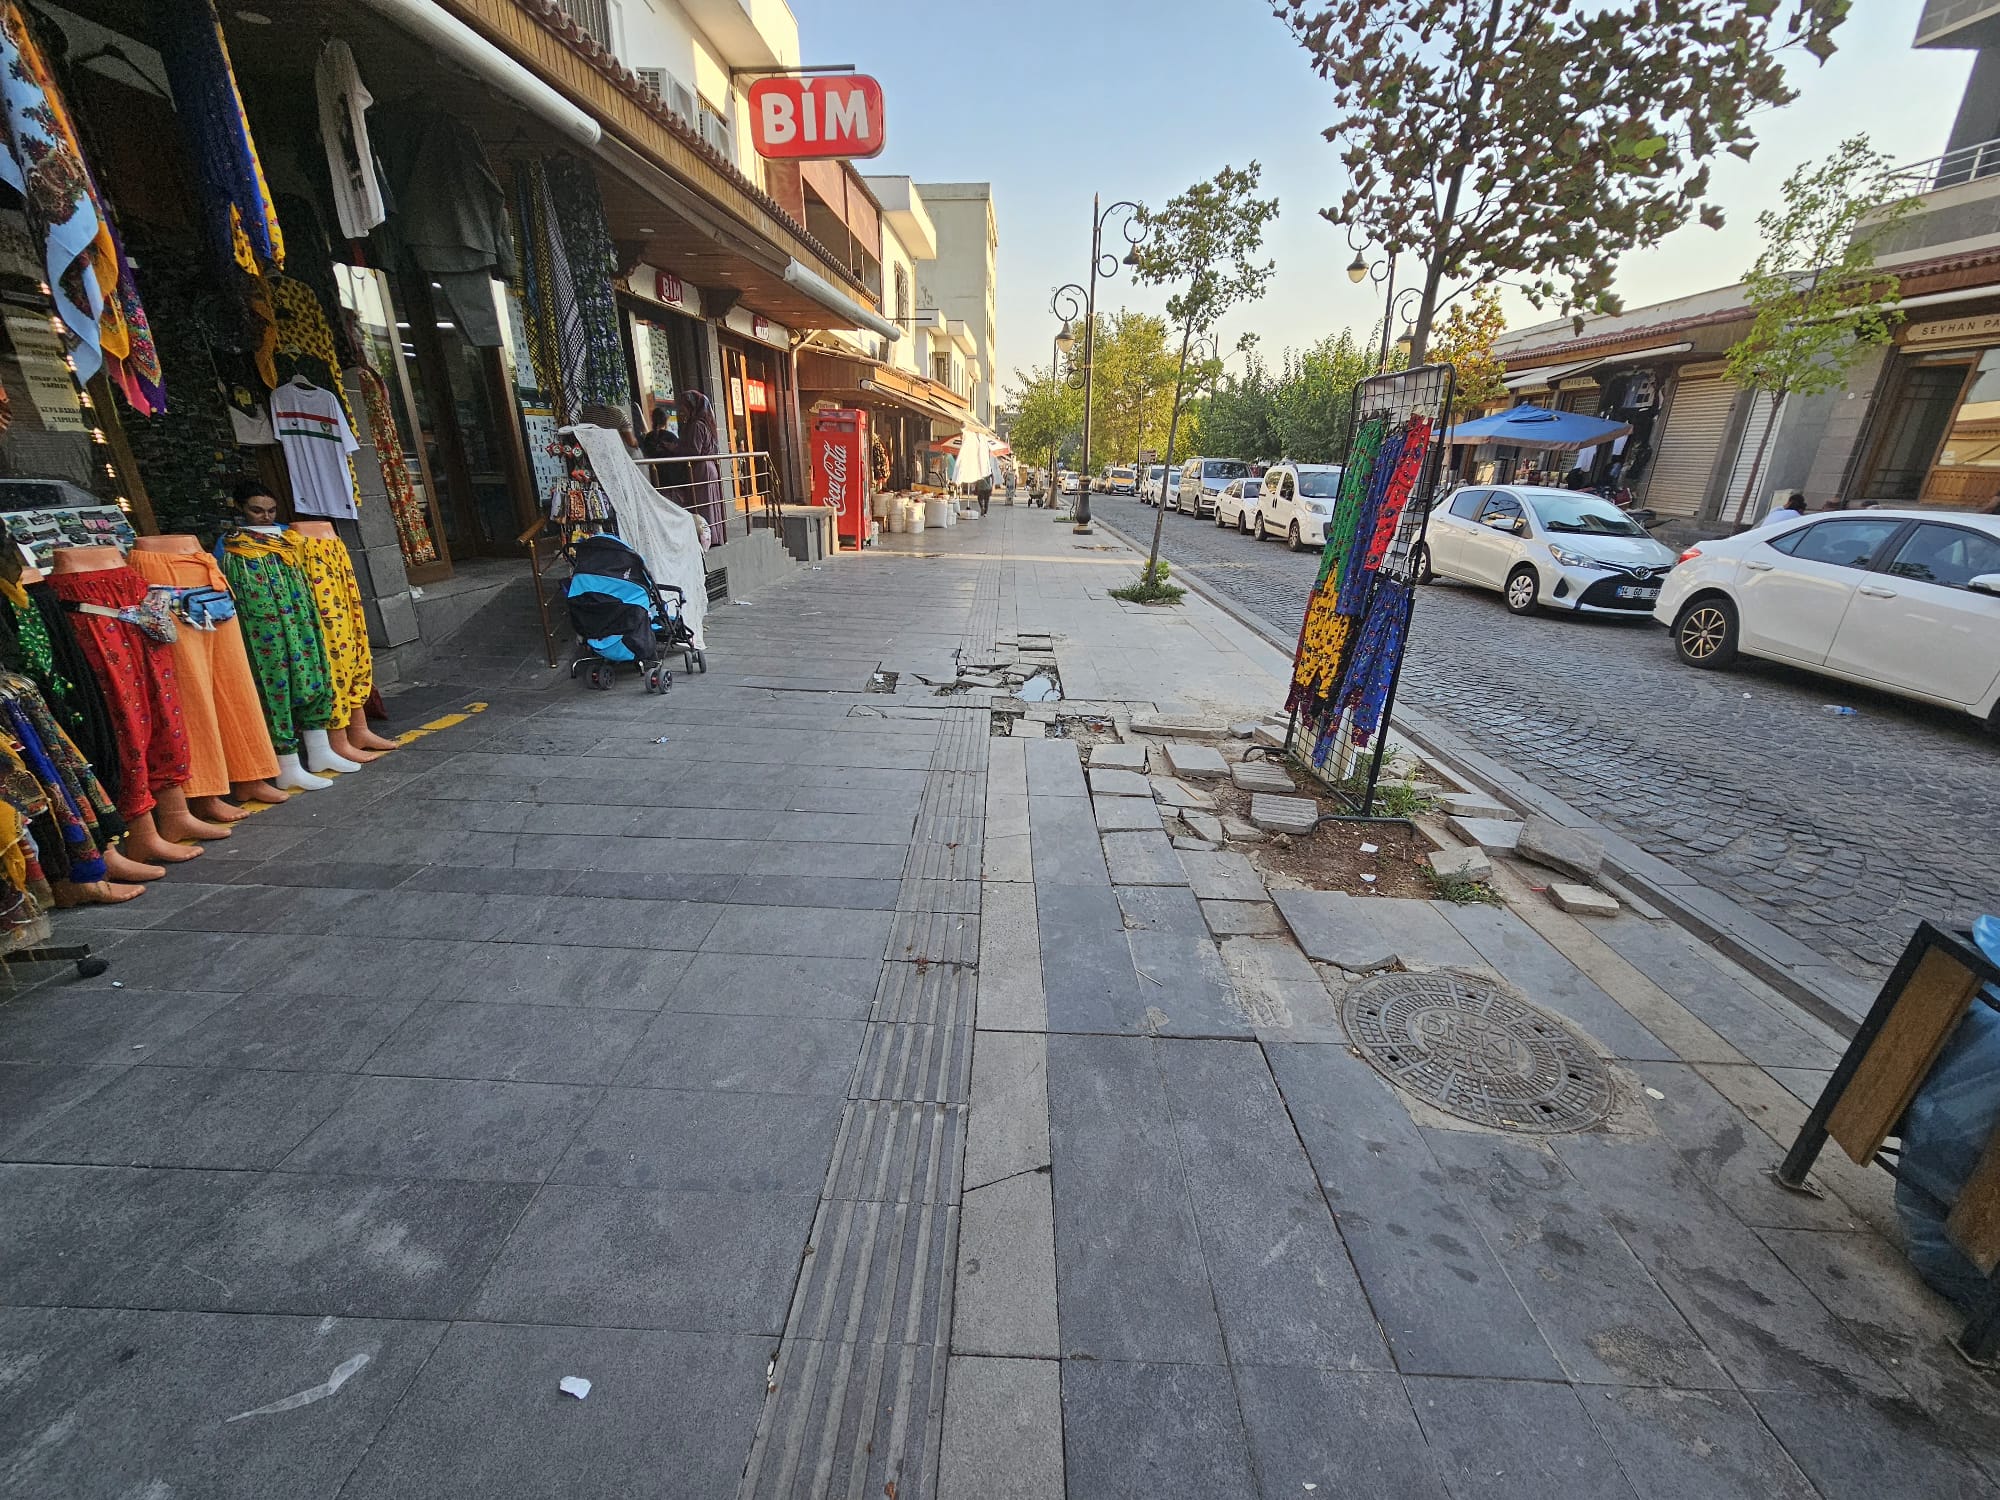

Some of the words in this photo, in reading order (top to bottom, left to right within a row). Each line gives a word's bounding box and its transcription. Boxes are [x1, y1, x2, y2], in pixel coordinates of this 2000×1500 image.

[760, 78, 869, 144] BİM
[662, 274, 682, 301] BİM
[1921, 321, 1976, 336] SEYHAN
